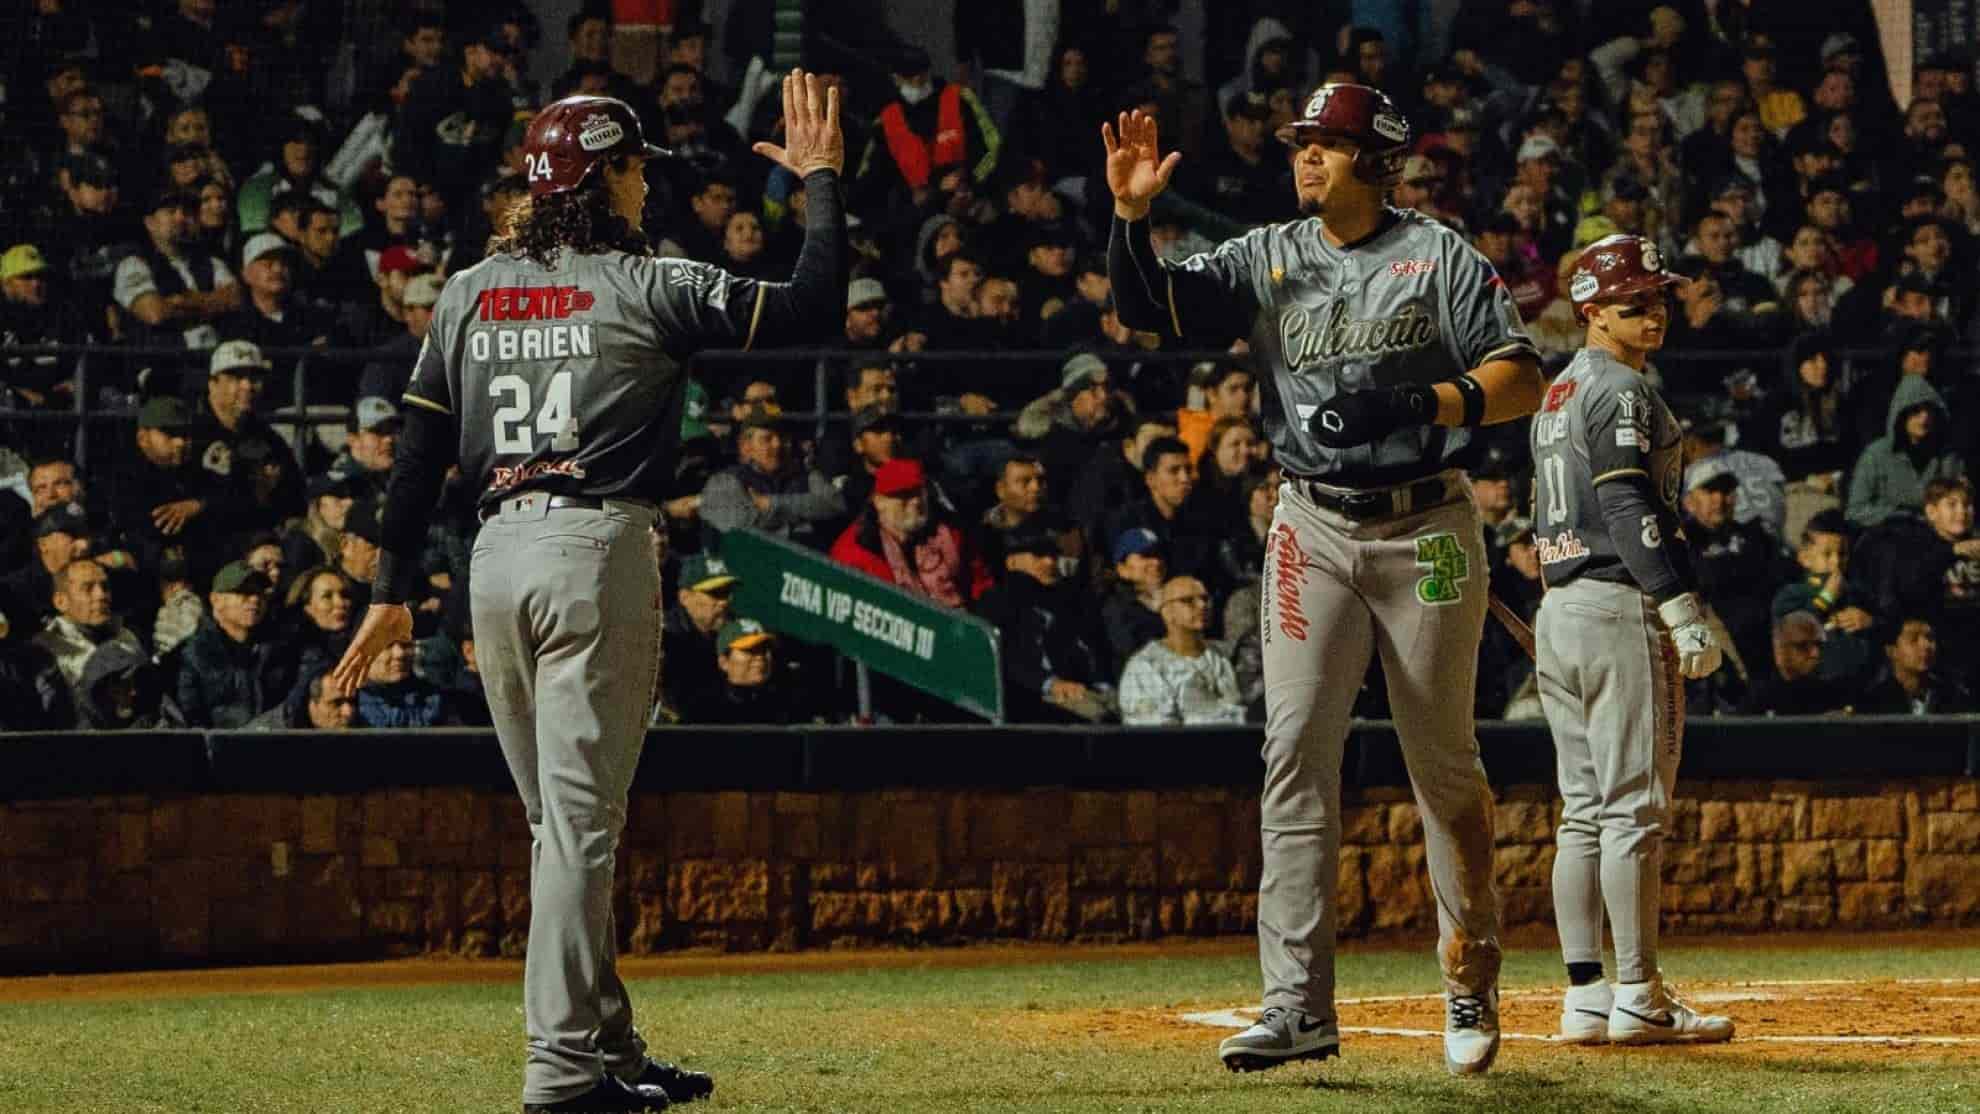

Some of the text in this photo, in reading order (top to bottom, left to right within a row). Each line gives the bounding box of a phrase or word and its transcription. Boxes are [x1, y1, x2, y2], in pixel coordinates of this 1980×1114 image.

[525, 152, 553, 182] 24
[479, 286, 573, 321] TECATE
[1281, 299, 1432, 371] Culiacán
[488, 371, 578, 454] 24
[781, 572, 822, 615] ZONA
[827, 588, 852, 624] VIP
[854, 601, 914, 652] SECCION
